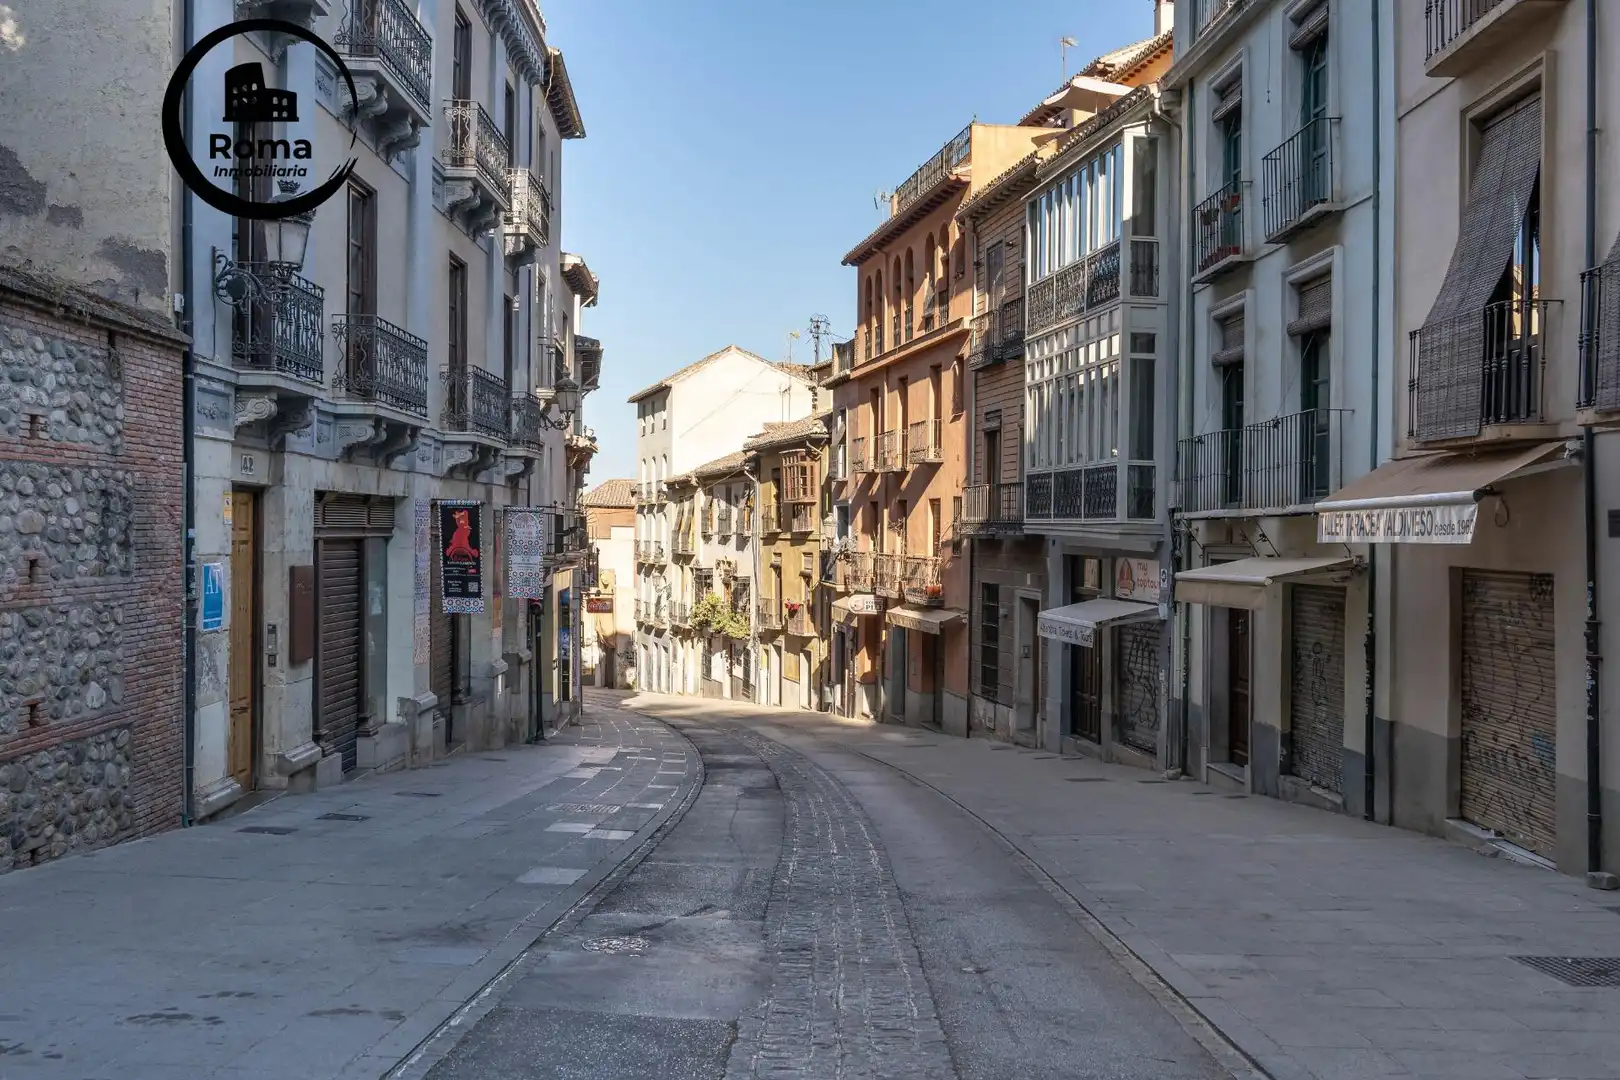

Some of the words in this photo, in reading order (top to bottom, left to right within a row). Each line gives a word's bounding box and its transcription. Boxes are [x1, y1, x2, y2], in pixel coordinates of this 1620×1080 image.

[1434, 519, 1456, 536] desde
[1136, 561, 1148, 577] my
[205, 568, 221, 595] AT
